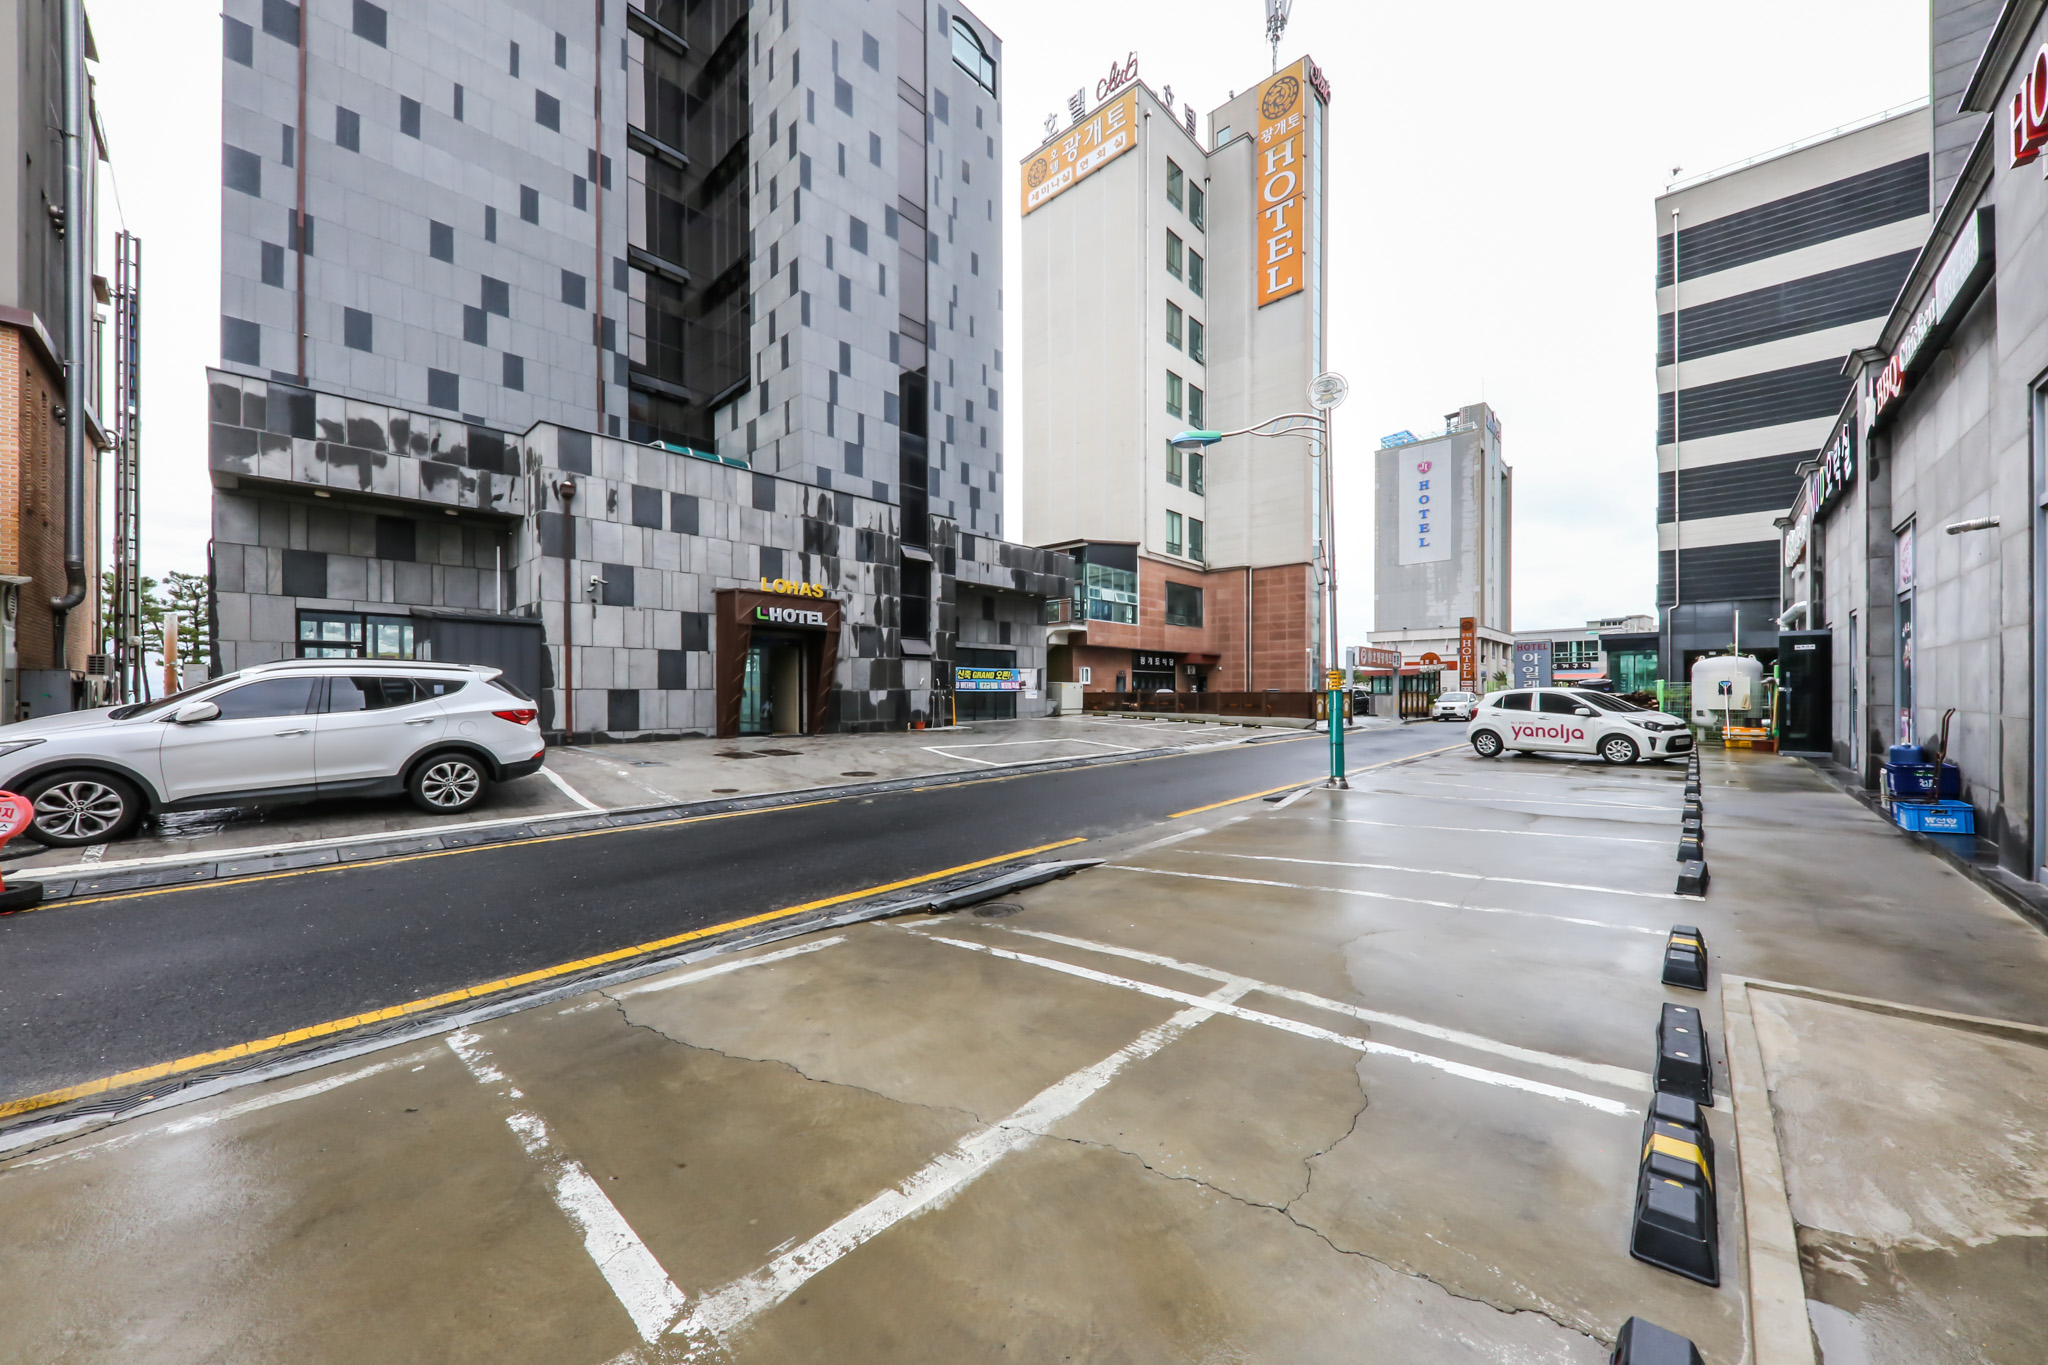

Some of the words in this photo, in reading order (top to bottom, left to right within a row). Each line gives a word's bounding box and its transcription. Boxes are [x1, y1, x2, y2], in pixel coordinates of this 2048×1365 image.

[1061, 102, 1127, 162] 광개토
[1260, 112, 1301, 144] 광개토
[1031, 172, 1071, 201] 세미나실
[1264, 137, 1297, 294] HOTEL
[1876, 355, 1902, 415] BBQ
[1418, 480, 1431, 547] HOTEL
[761, 577, 824, 598] LOHAS
[1462, 640, 1471, 679] HOTEL
[1516, 643, 1548, 651] HOTEL
[956, 669, 972, 680] 신축
[972, 671, 995, 680] GRAND
[1511, 724, 1584, 743] yanolja
